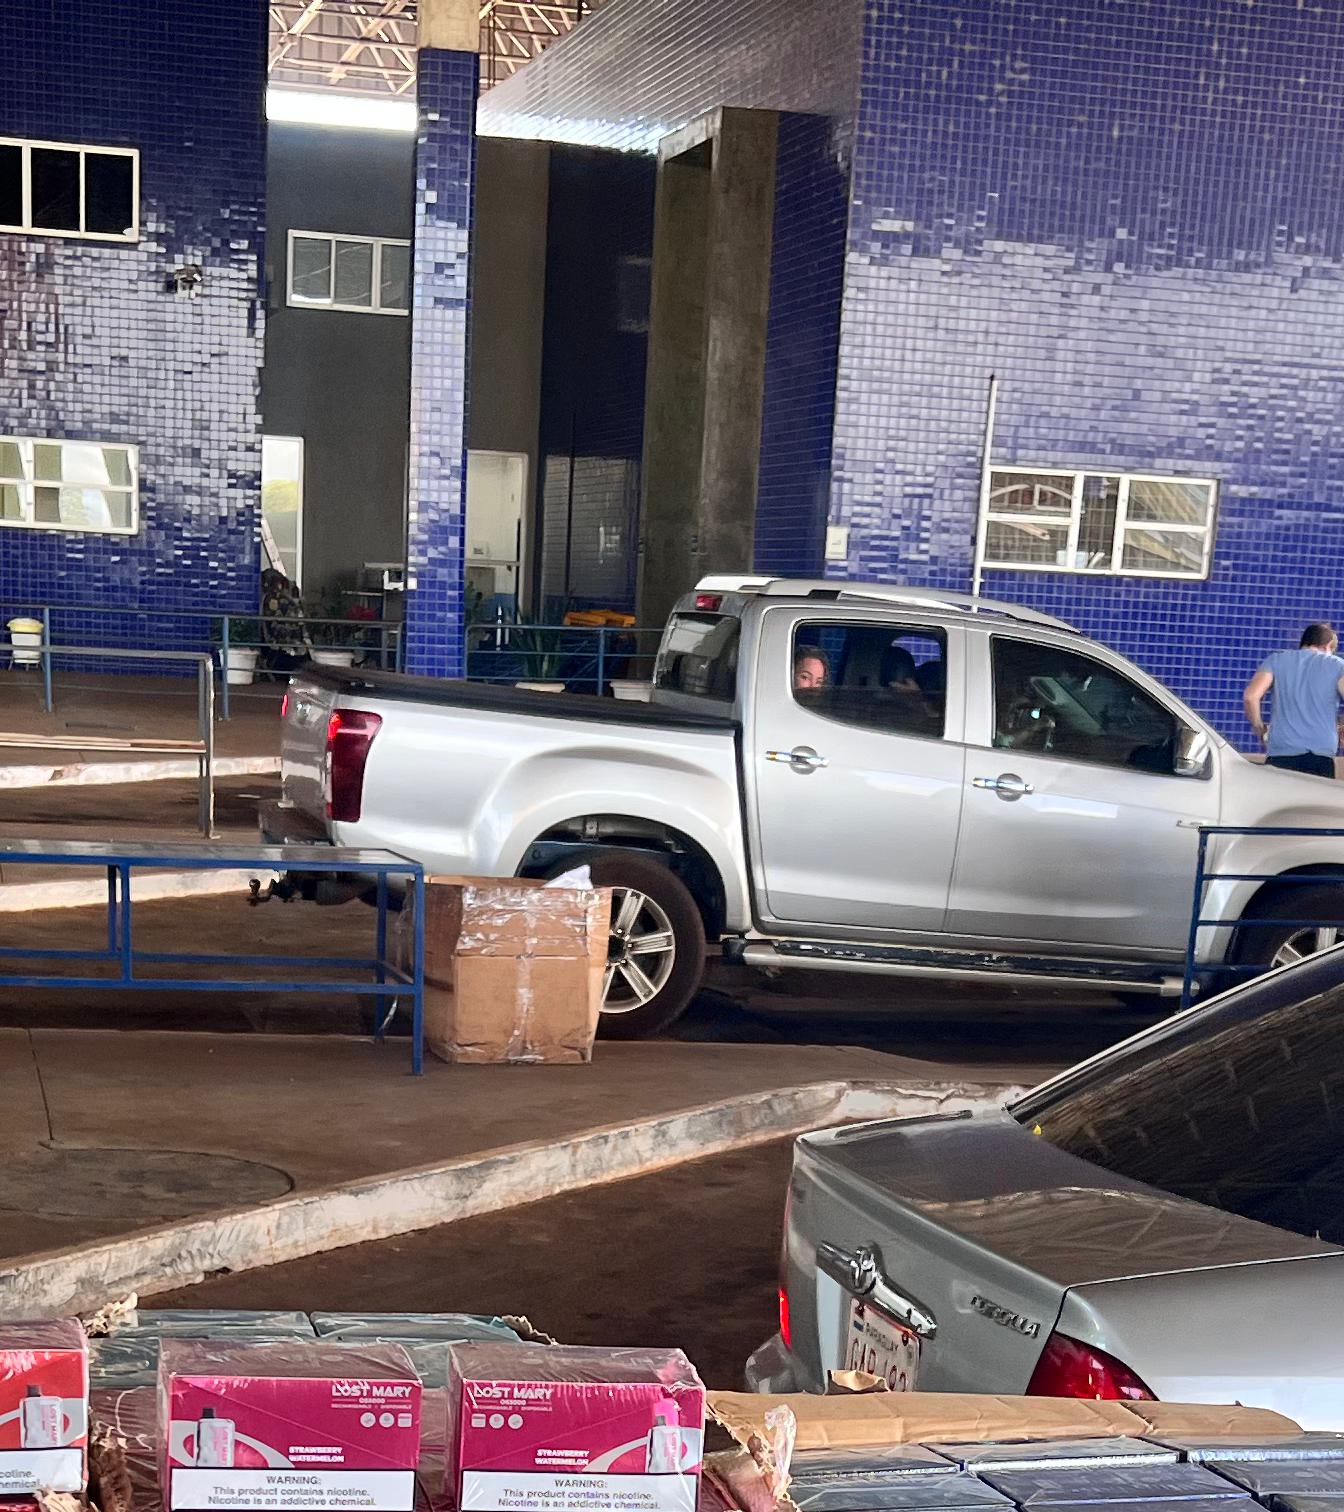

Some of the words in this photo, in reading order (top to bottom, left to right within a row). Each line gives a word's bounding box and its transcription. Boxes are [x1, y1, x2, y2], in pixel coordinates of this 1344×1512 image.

[332, 1384, 370, 1396] LOST
[372, 1386, 412, 1397] MARY
[474, 1387, 511, 1398] LOST
[513, 1388, 554, 1399] MARY
[266, 1476, 321, 1485] WARNING:
[554, 1480, 607, 1488] WARNING:
[213, 1487, 235, 1495] This
[238, 1488, 277, 1497] product
[504, 1489, 523, 1497] This
[527, 1491, 565, 1499] product
[568, 1491, 609, 1499] contains
[208, 1496, 250, 1504] Nicotine
[253, 1497, 262, 1505] is
[280, 1497, 326, 1505] addictive
[498, 1498, 538, 1507] Nicotine
[567, 1500, 611, 1508] addictive
